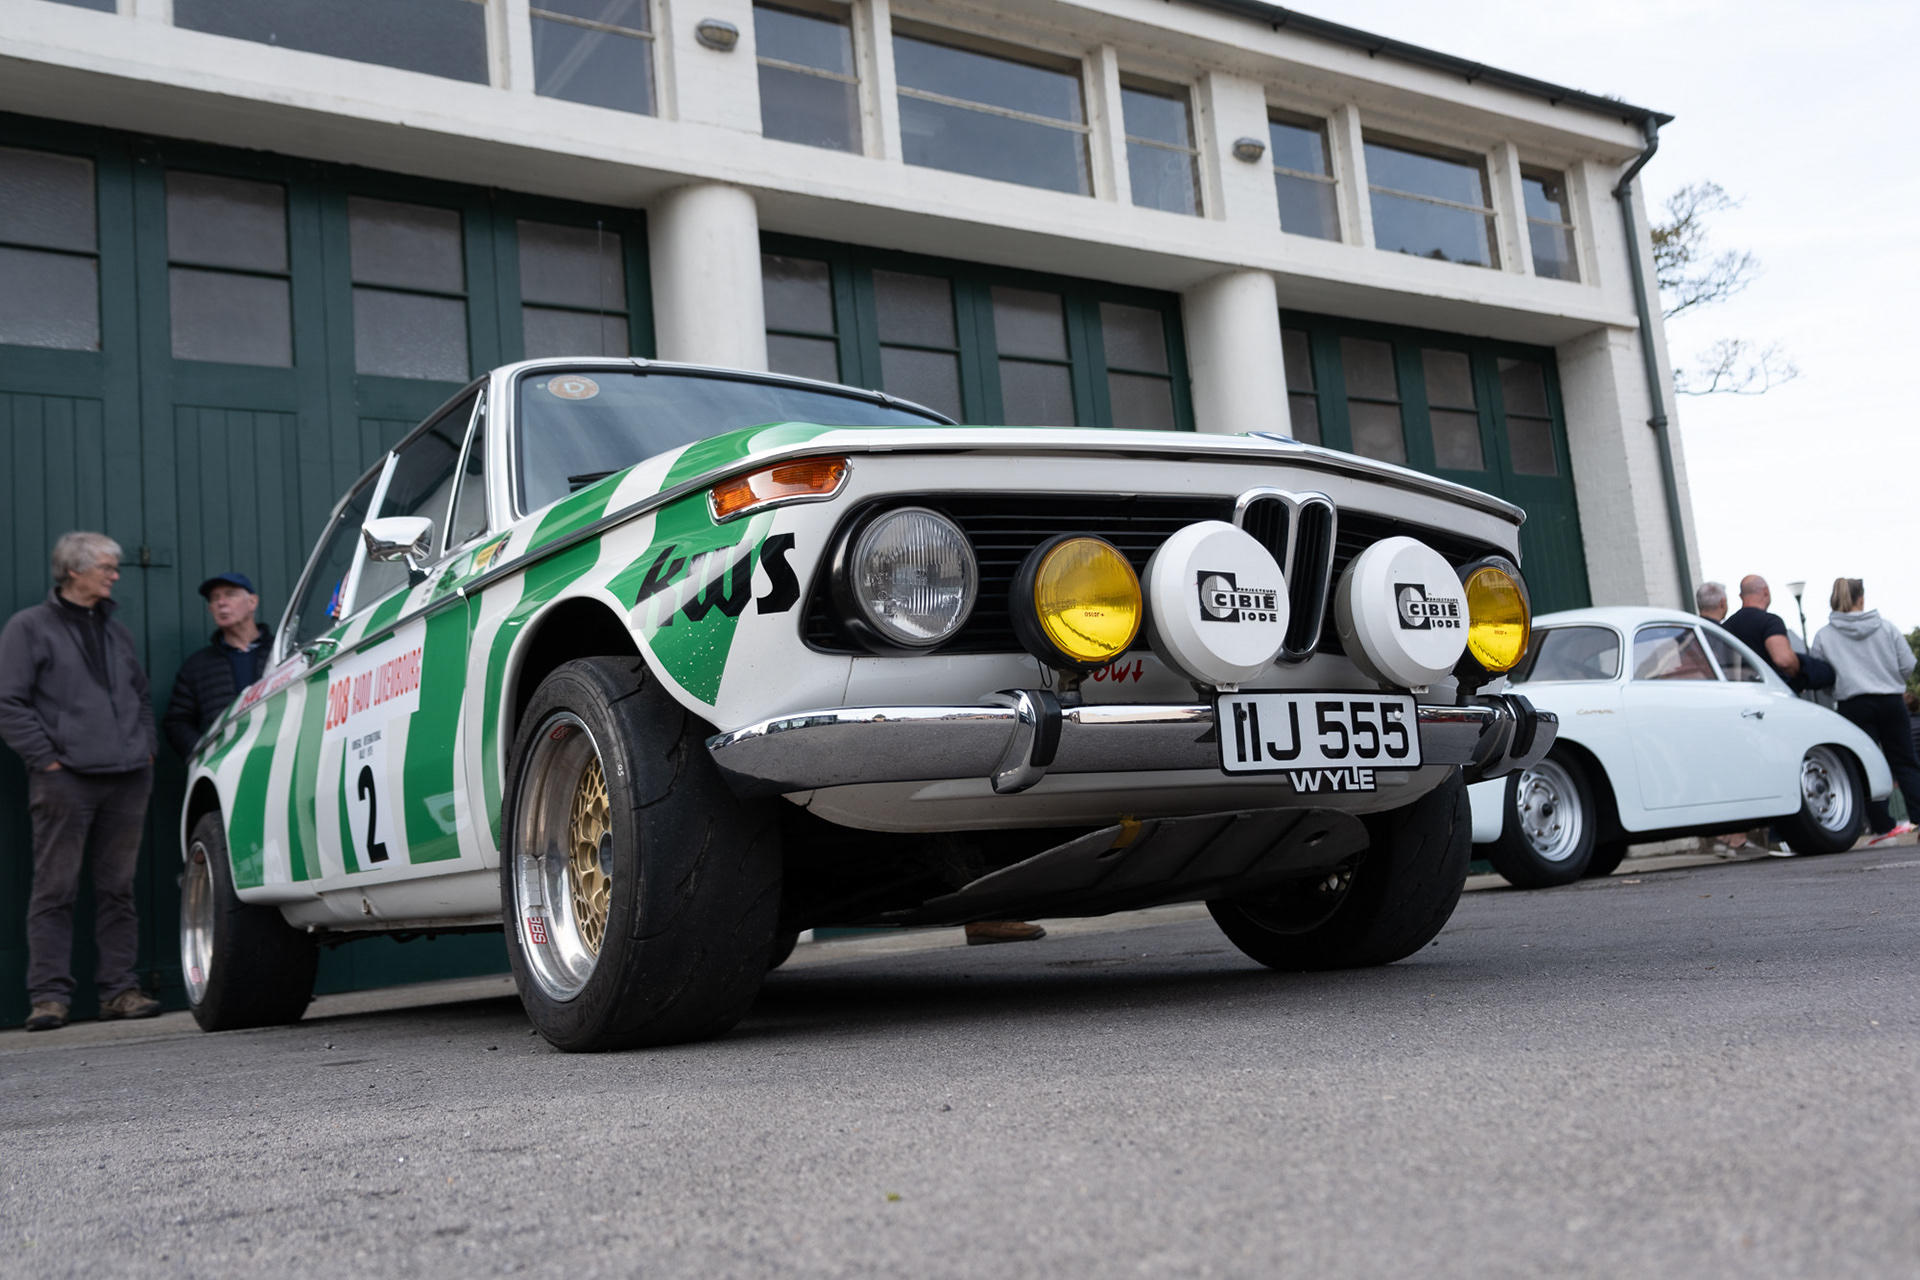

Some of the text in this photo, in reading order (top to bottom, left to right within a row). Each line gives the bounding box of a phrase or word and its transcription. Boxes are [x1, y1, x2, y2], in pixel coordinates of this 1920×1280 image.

[1241, 611, 1278, 623] IODE
[1431, 619, 1461, 629] IODE
[325, 676, 351, 731] 208
[352, 670, 373, 715] RADIO
[1315, 701, 1410, 760] 555
[1289, 769, 1375, 792] WYLE
[358, 764, 390, 864] 2
